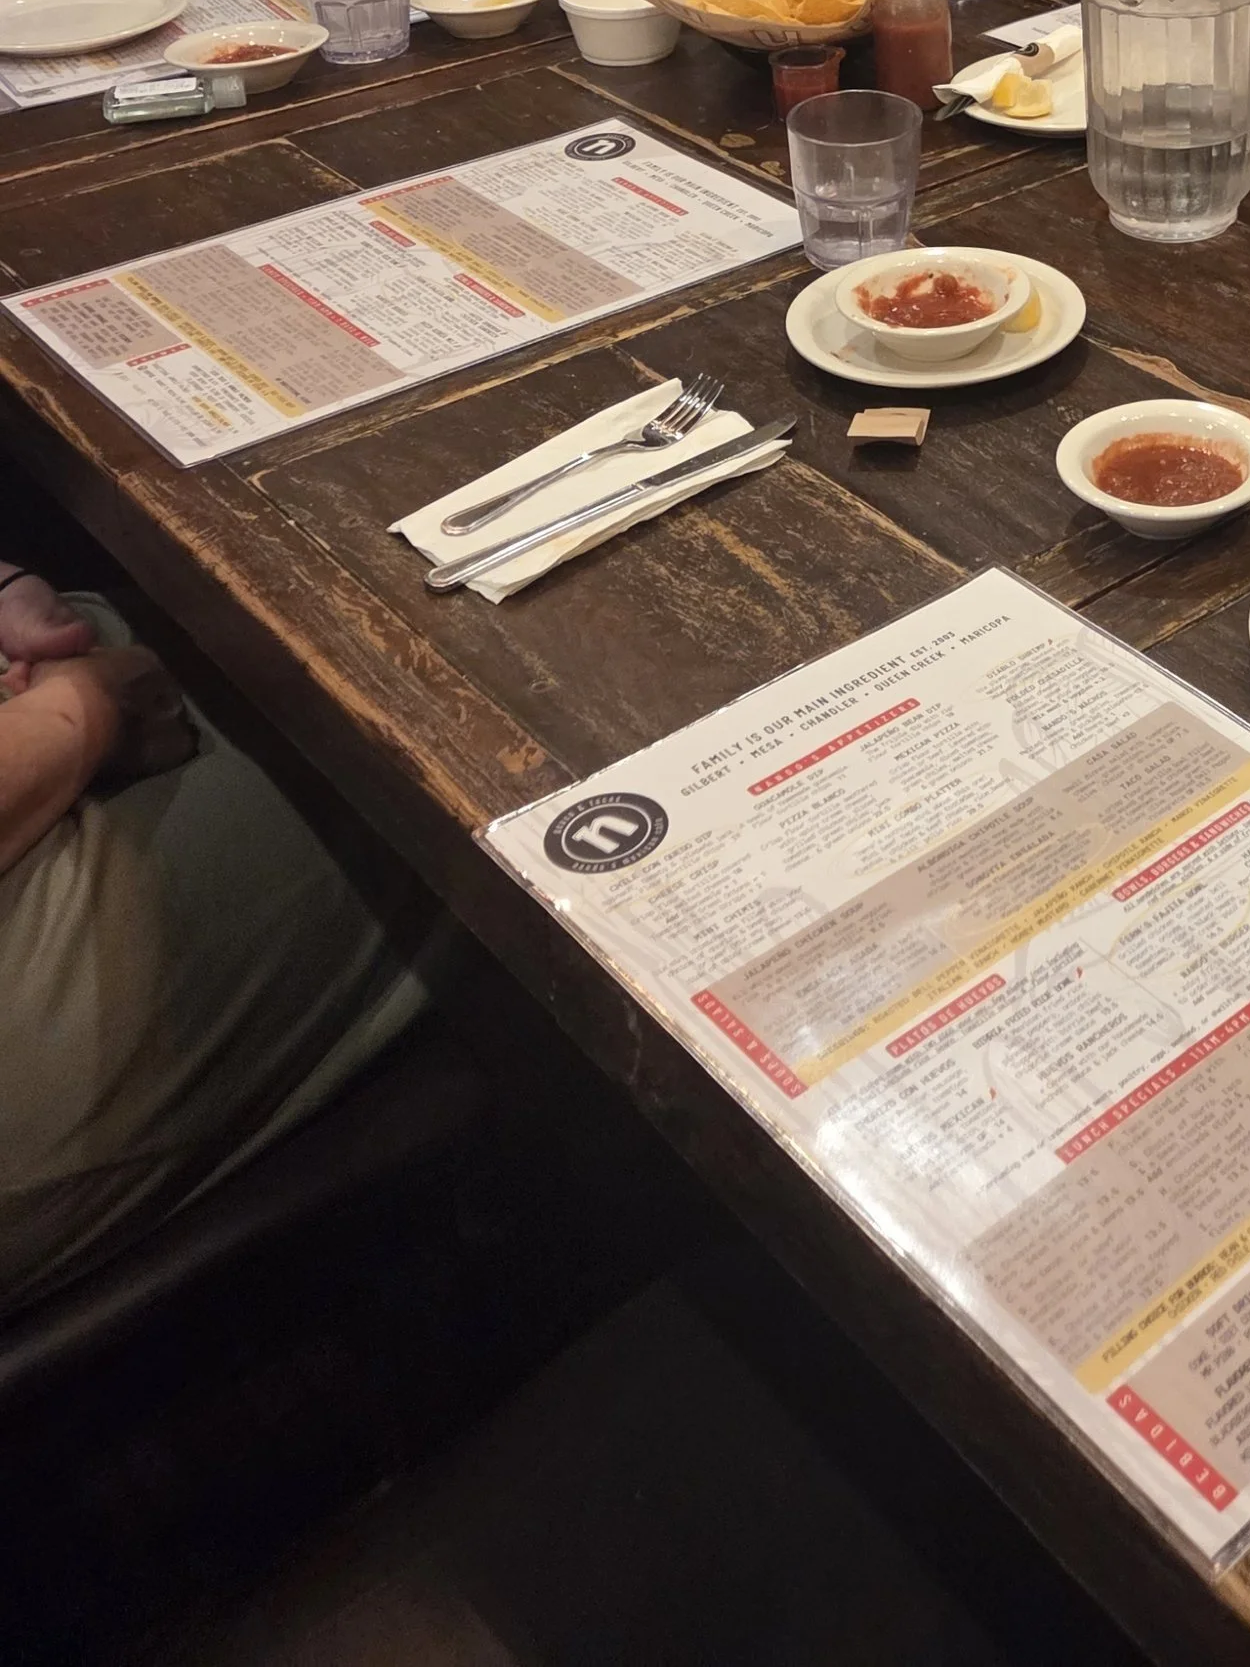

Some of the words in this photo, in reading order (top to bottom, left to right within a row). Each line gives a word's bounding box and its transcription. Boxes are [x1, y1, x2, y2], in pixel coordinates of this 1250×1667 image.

[677, 764, 734, 797] GILBERT
[748, 737, 785, 759] MESA
[797, 696, 861, 732] CHANDLER
[870, 668, 912, 692] QUEEN
[908, 649, 947, 672] CREEK
[957, 614, 1013, 645] MARICOPA
[688, 741, 746, 775] FAMILY
[761, 714, 795, 735] OUR
[791, 695, 831, 718] MAIN
[827, 655, 909, 699] INGREDIENT
[929, 630, 958, 646] 2003
[824, 699, 918, 752] APPETIZERS
[571, 815, 640, 854] n
[1147, 844, 1193, 876] BURGERS
[888, 1019, 939, 1056] PLATOS
[954, 976, 1004, 1011] HUEVOS
[1061, 1118, 1112, 1159] LUNCH
[1109, 1067, 1179, 1121] SPECIALS
[1115, 1390, 1230, 1501] BEBIDAS
